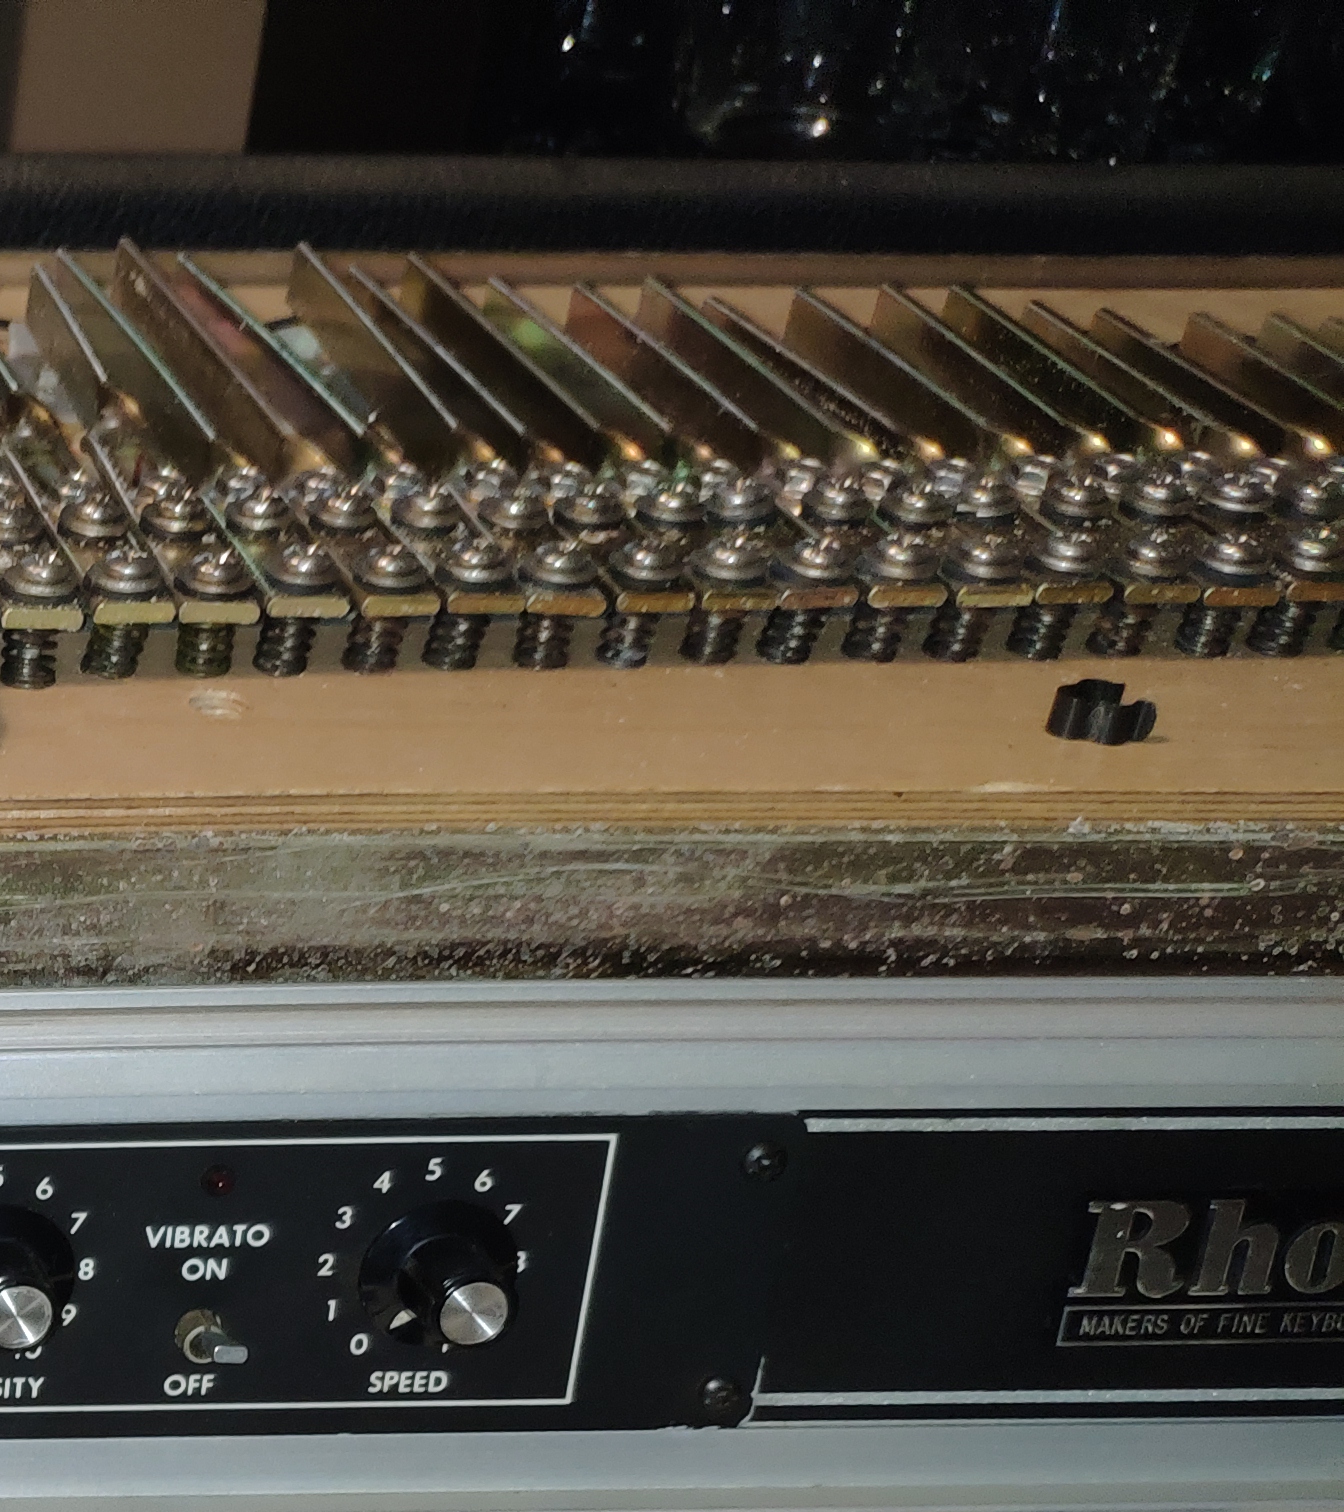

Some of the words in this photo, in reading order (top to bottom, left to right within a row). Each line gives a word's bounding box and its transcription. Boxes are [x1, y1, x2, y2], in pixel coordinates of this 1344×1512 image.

[424, 1157, 443, 1181] 5
[474, 1169, 493, 1193] 6
[35, 1176, 54, 1201] 6
[372, 1170, 392, 1194] 4
[70, 1211, 88, 1235] 7
[335, 1205, 353, 1230] 3
[503, 1203, 523, 1226] 7
[145, 1223, 271, 1249] VIBRATO
[77, 1257, 95, 1281] 8
[181, 1257, 229, 1282] ON
[317, 1253, 335, 1277] 2
[61, 1303, 77, 1327] 9
[327, 1299, 337, 1322] 1
[1078, 1313, 1170, 1336] MAKERS
[1179, 1312, 1210, 1335] OF
[1217, 1311, 1269, 1334] FINE
[349, 1332, 369, 1356] 0
[163, 1373, 215, 1397] OFF
[367, 1370, 449, 1394] SPEED
